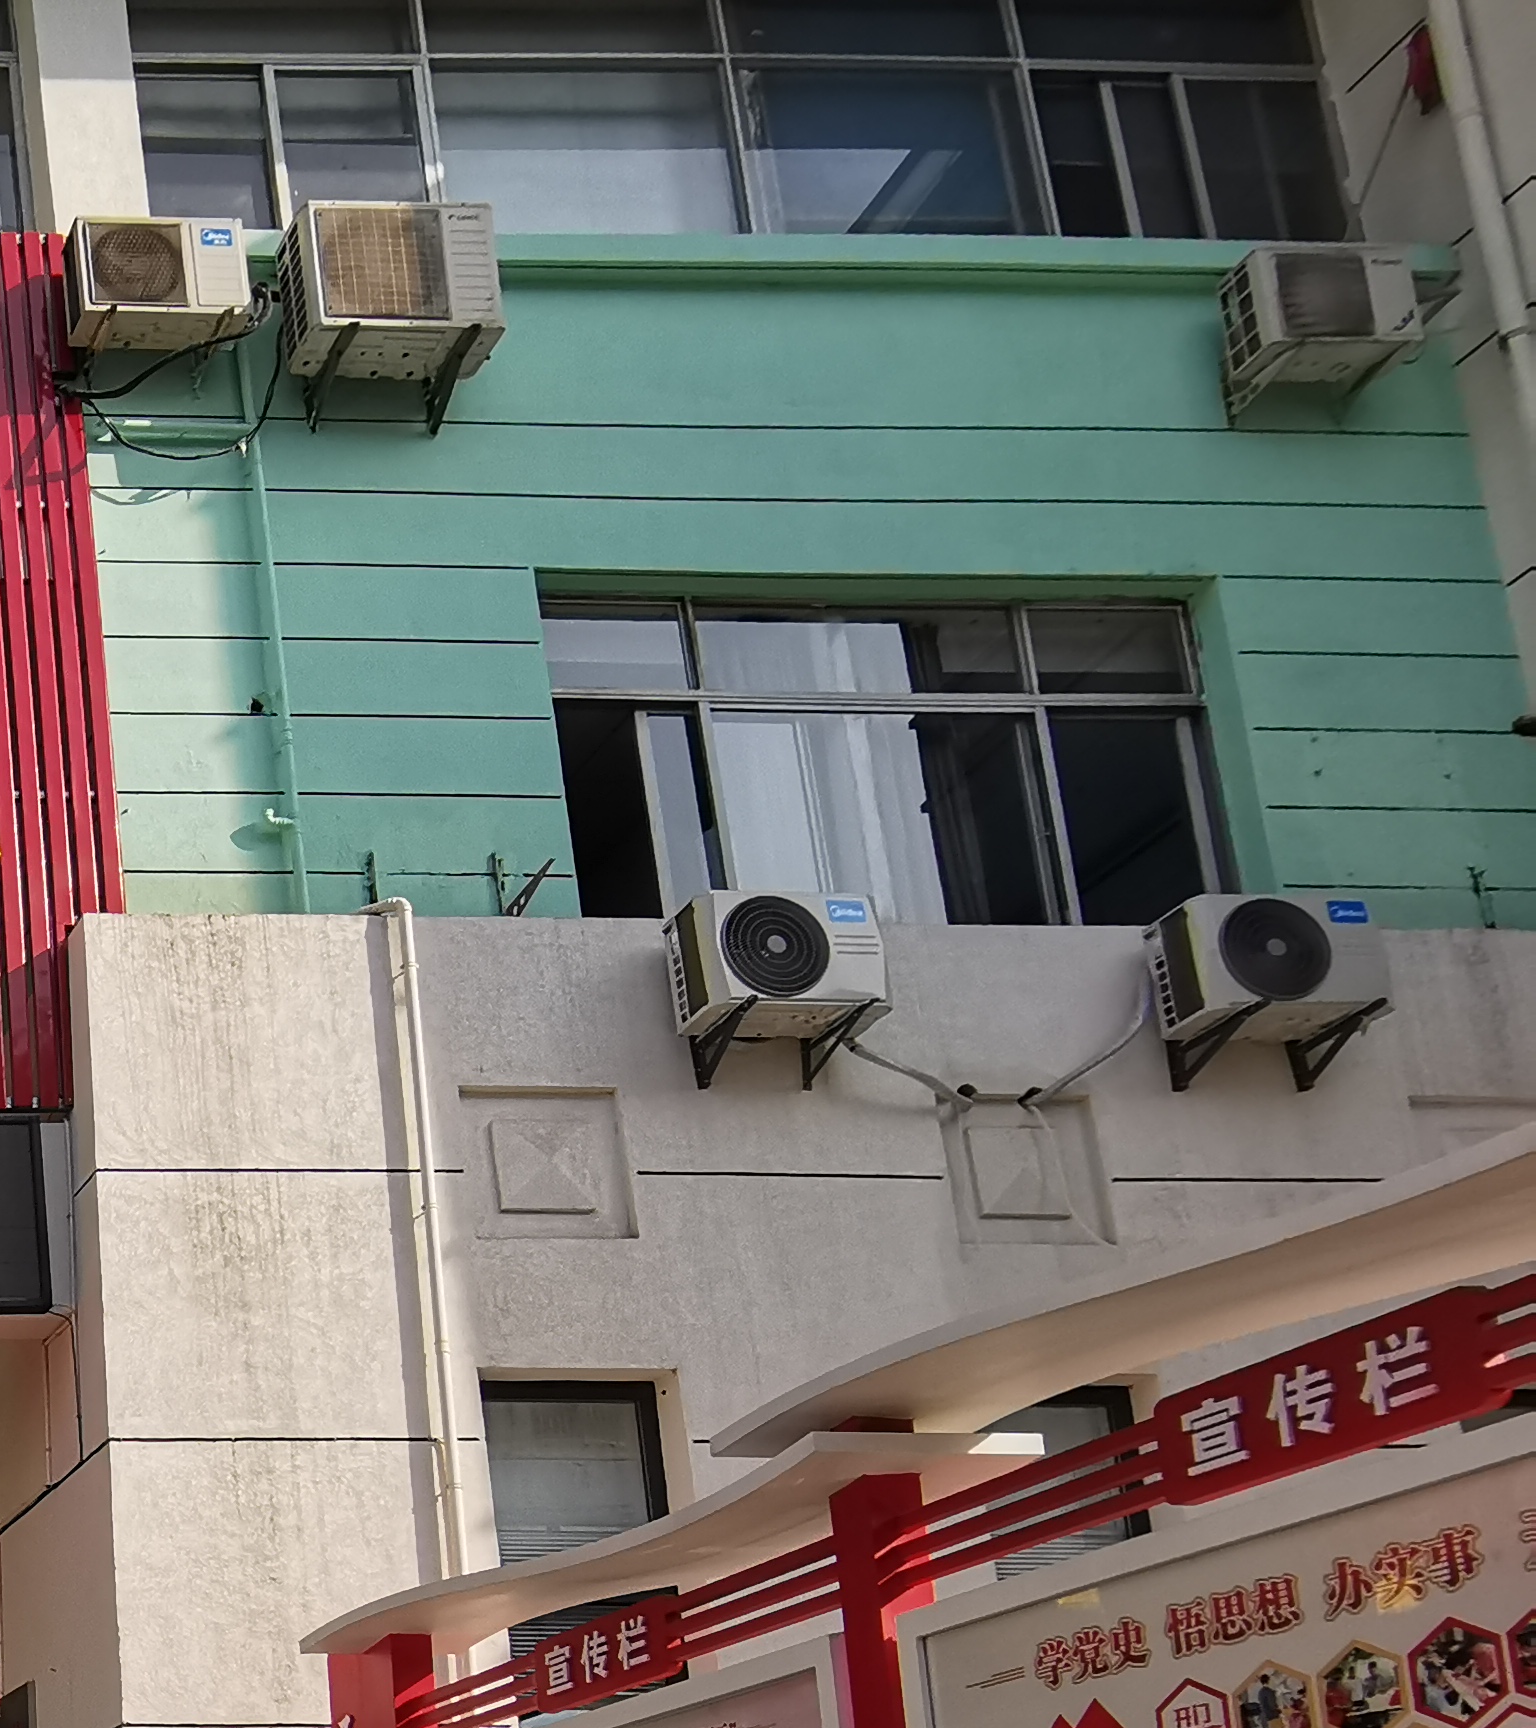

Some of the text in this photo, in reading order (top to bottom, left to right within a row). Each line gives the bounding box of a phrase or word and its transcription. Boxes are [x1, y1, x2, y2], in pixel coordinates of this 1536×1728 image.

[1180, 1326, 1439, 1477] 宣传栏
[544, 1615, 651, 1695] 宣传栏
[1035, 1523, 1485, 1689] 学党史 悟思想 办实事
